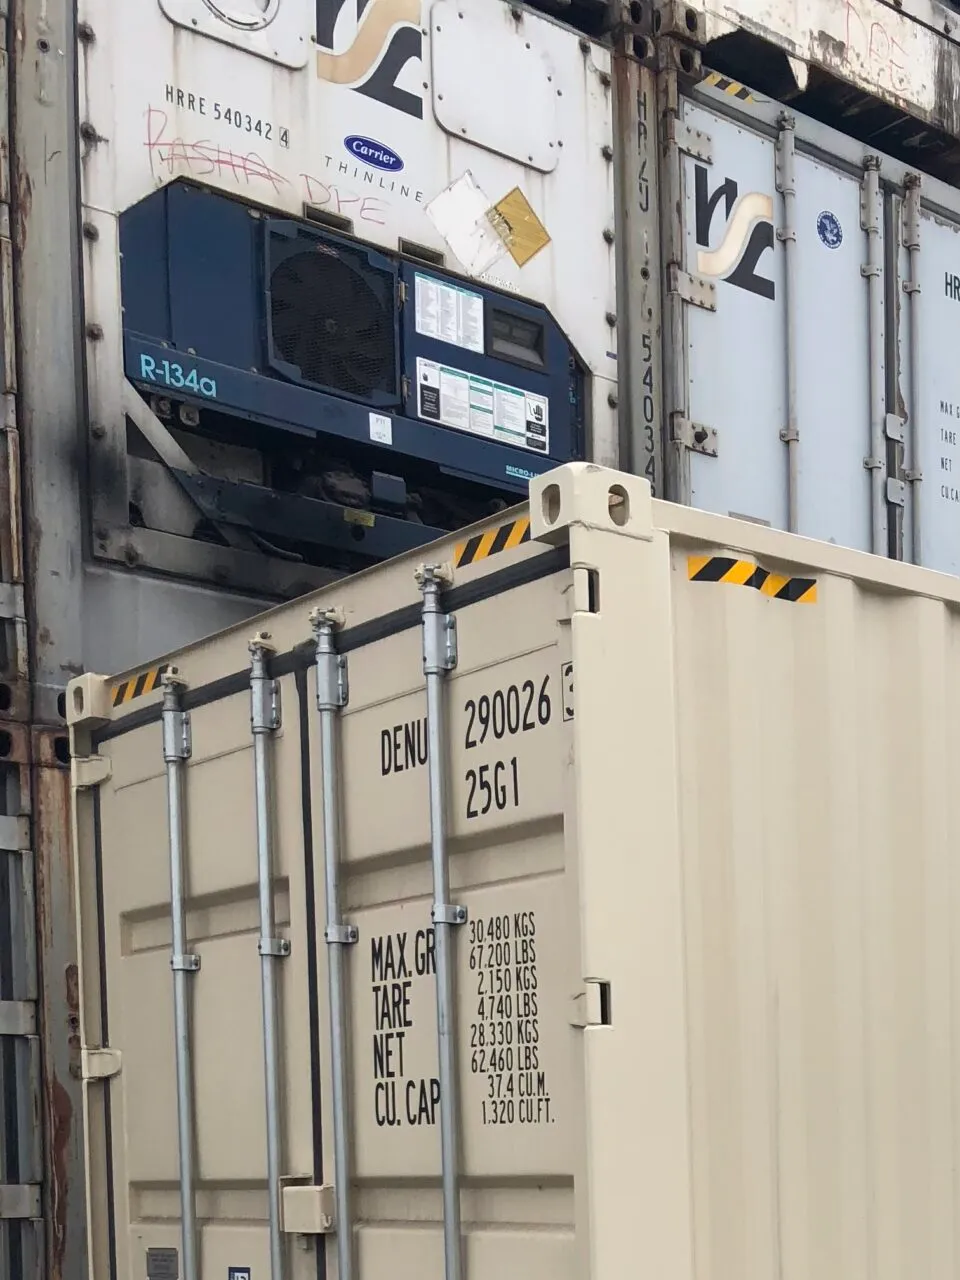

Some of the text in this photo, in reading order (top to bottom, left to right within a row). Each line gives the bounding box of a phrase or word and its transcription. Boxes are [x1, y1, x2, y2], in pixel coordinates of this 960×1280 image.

[165, 84, 289, 147] HRRE 540342 4
[351, 140, 397, 166] Carrier
[324, 155, 424, 203] THINLINE
[140, 353, 217, 398] R-134a
[940, 400, 953, 417] MAX
[940, 428, 957, 446] TARE
[940, 456, 952, 472] NET
[464, 674, 551, 750] 290026
[381, 717, 428, 776] DENU
[465, 756, 519, 819] 25G1
[514, 911, 536, 938] KGS
[515, 938, 536, 965] LBS
[516, 965, 538, 992] KGS
[372, 981, 412, 1030] TARE
[516, 992, 538, 1018] LBS
[517, 1018, 539, 1044] KGS
[373, 1031, 405, 1079] NET
[518, 1045, 539, 1071] LBS
[487, 1072, 514, 1098] 37.4
